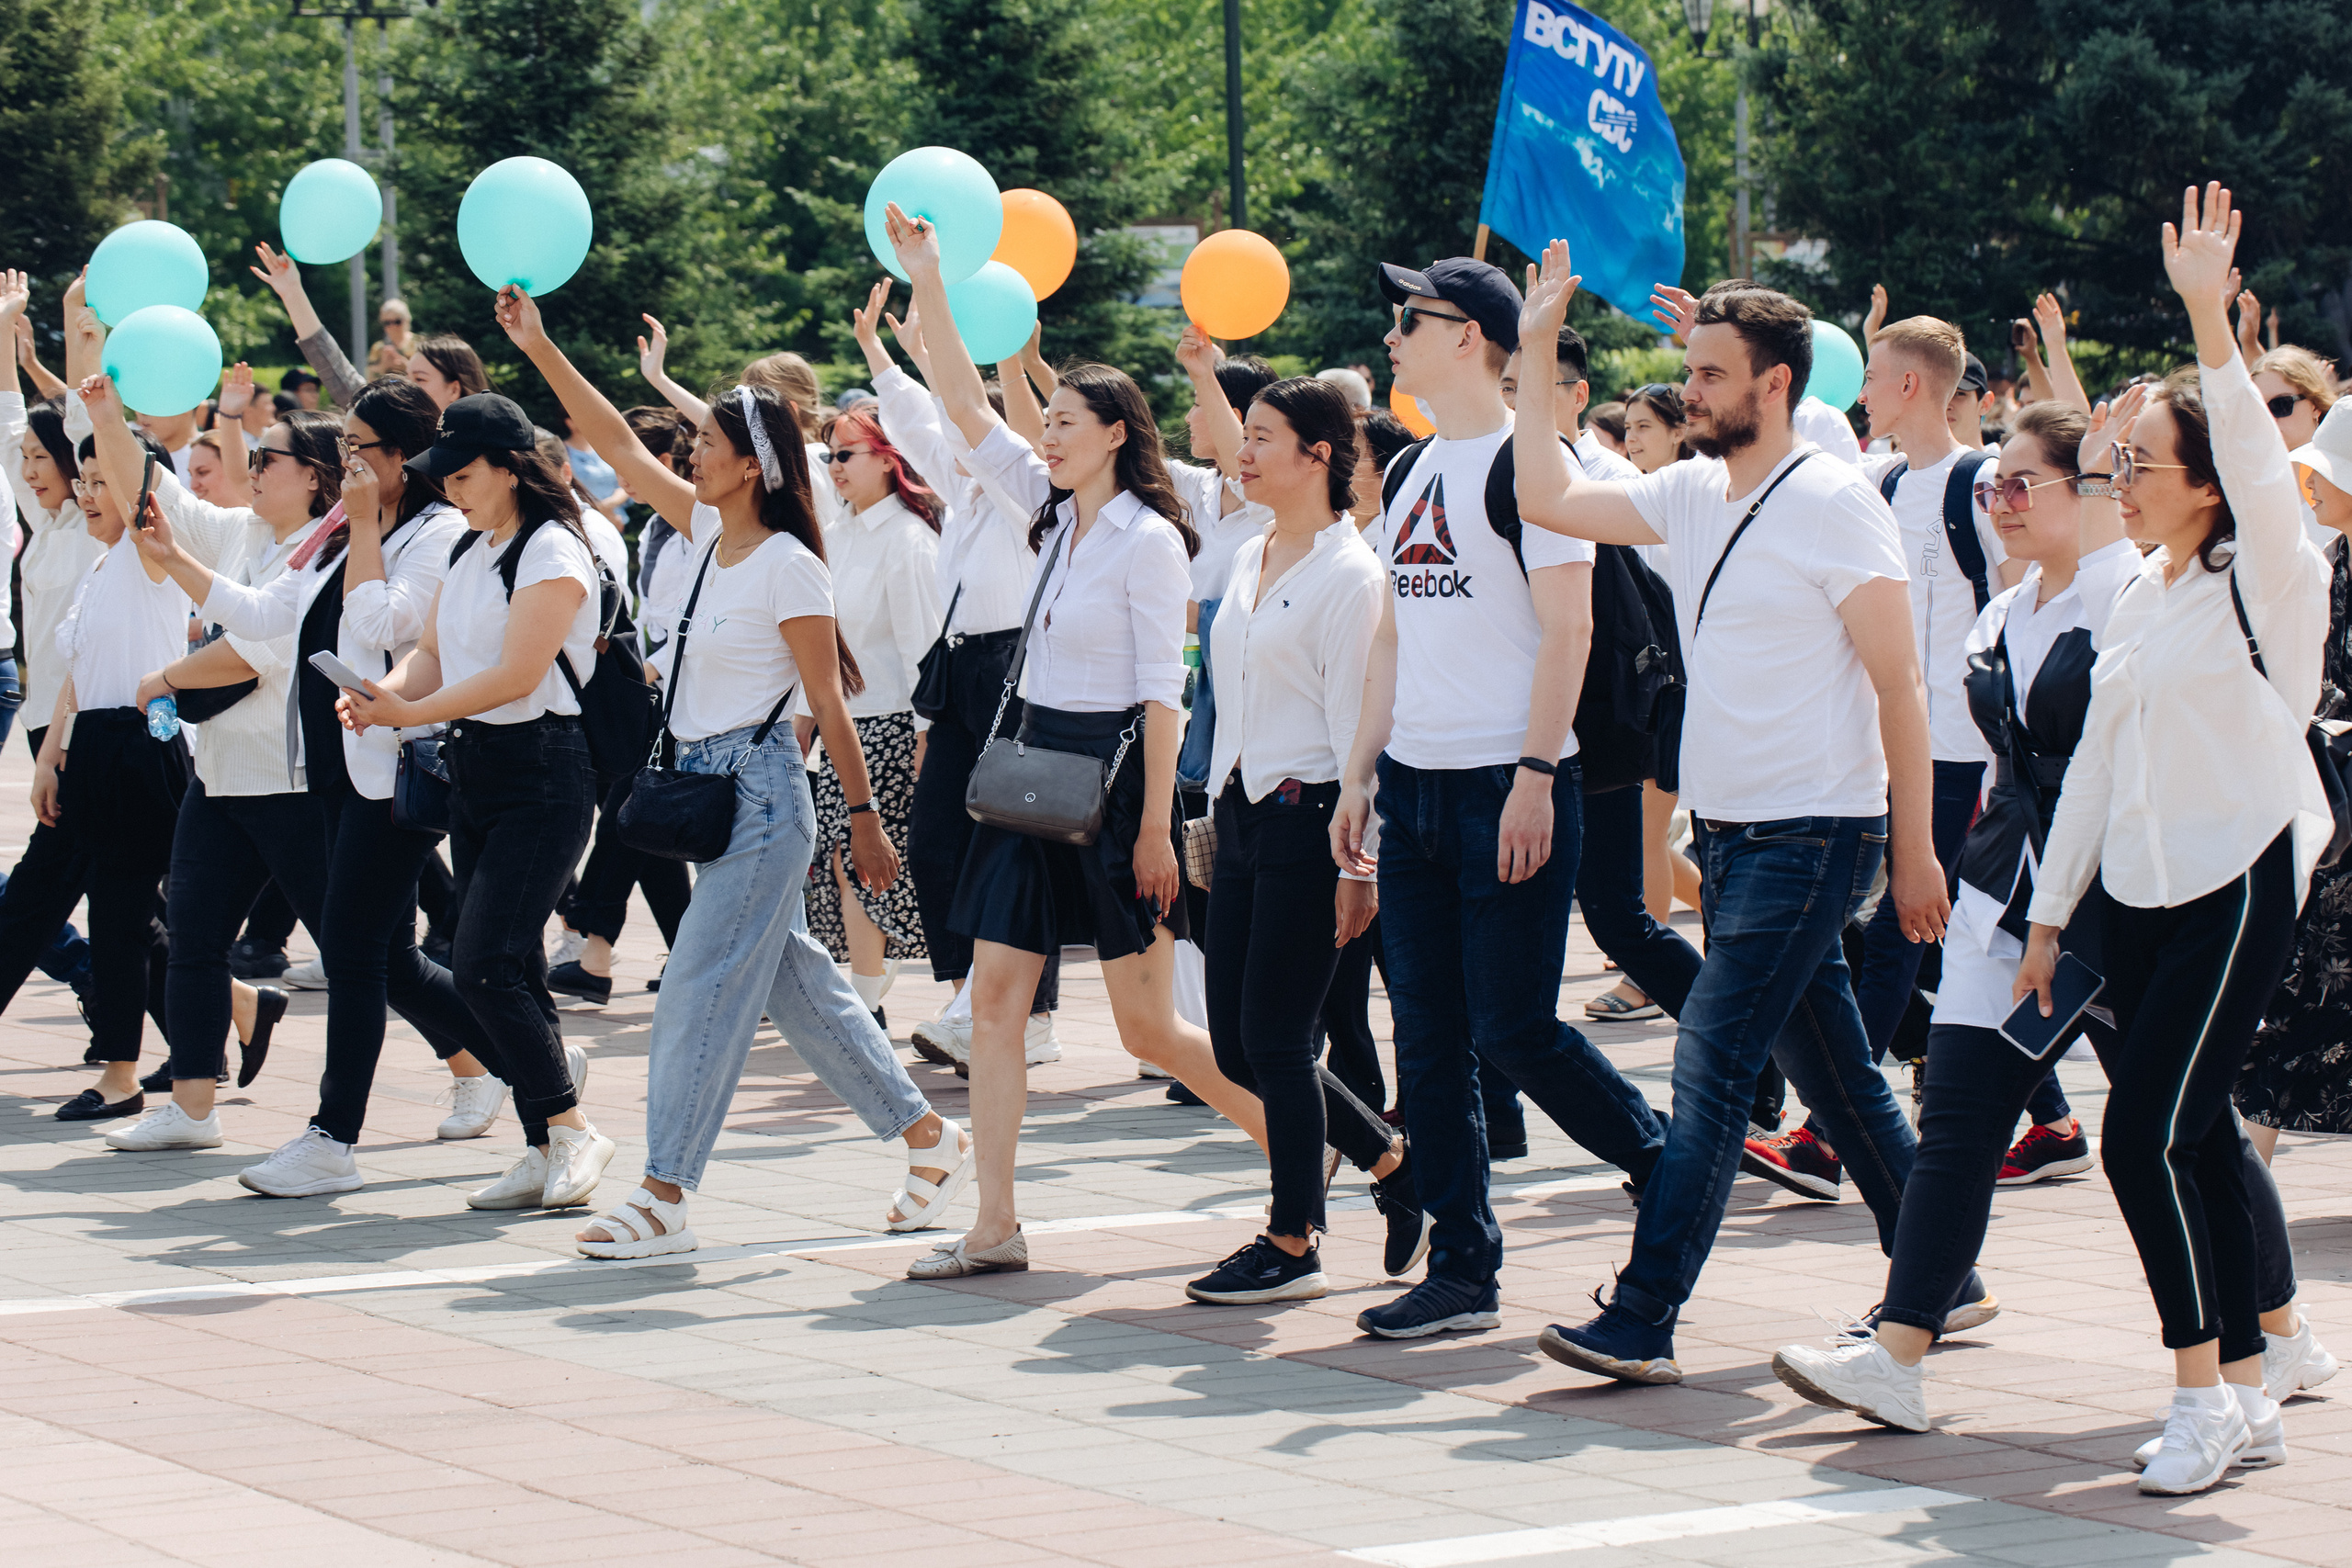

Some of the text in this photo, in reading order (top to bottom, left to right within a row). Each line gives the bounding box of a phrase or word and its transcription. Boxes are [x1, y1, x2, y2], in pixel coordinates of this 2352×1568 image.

[1523, 0, 1645, 97] ВСГУТУ
[1398, 278, 1422, 291] adidas
[1920, 518, 1944, 577] FILA
[1390, 569, 1474, 598] Reebok
